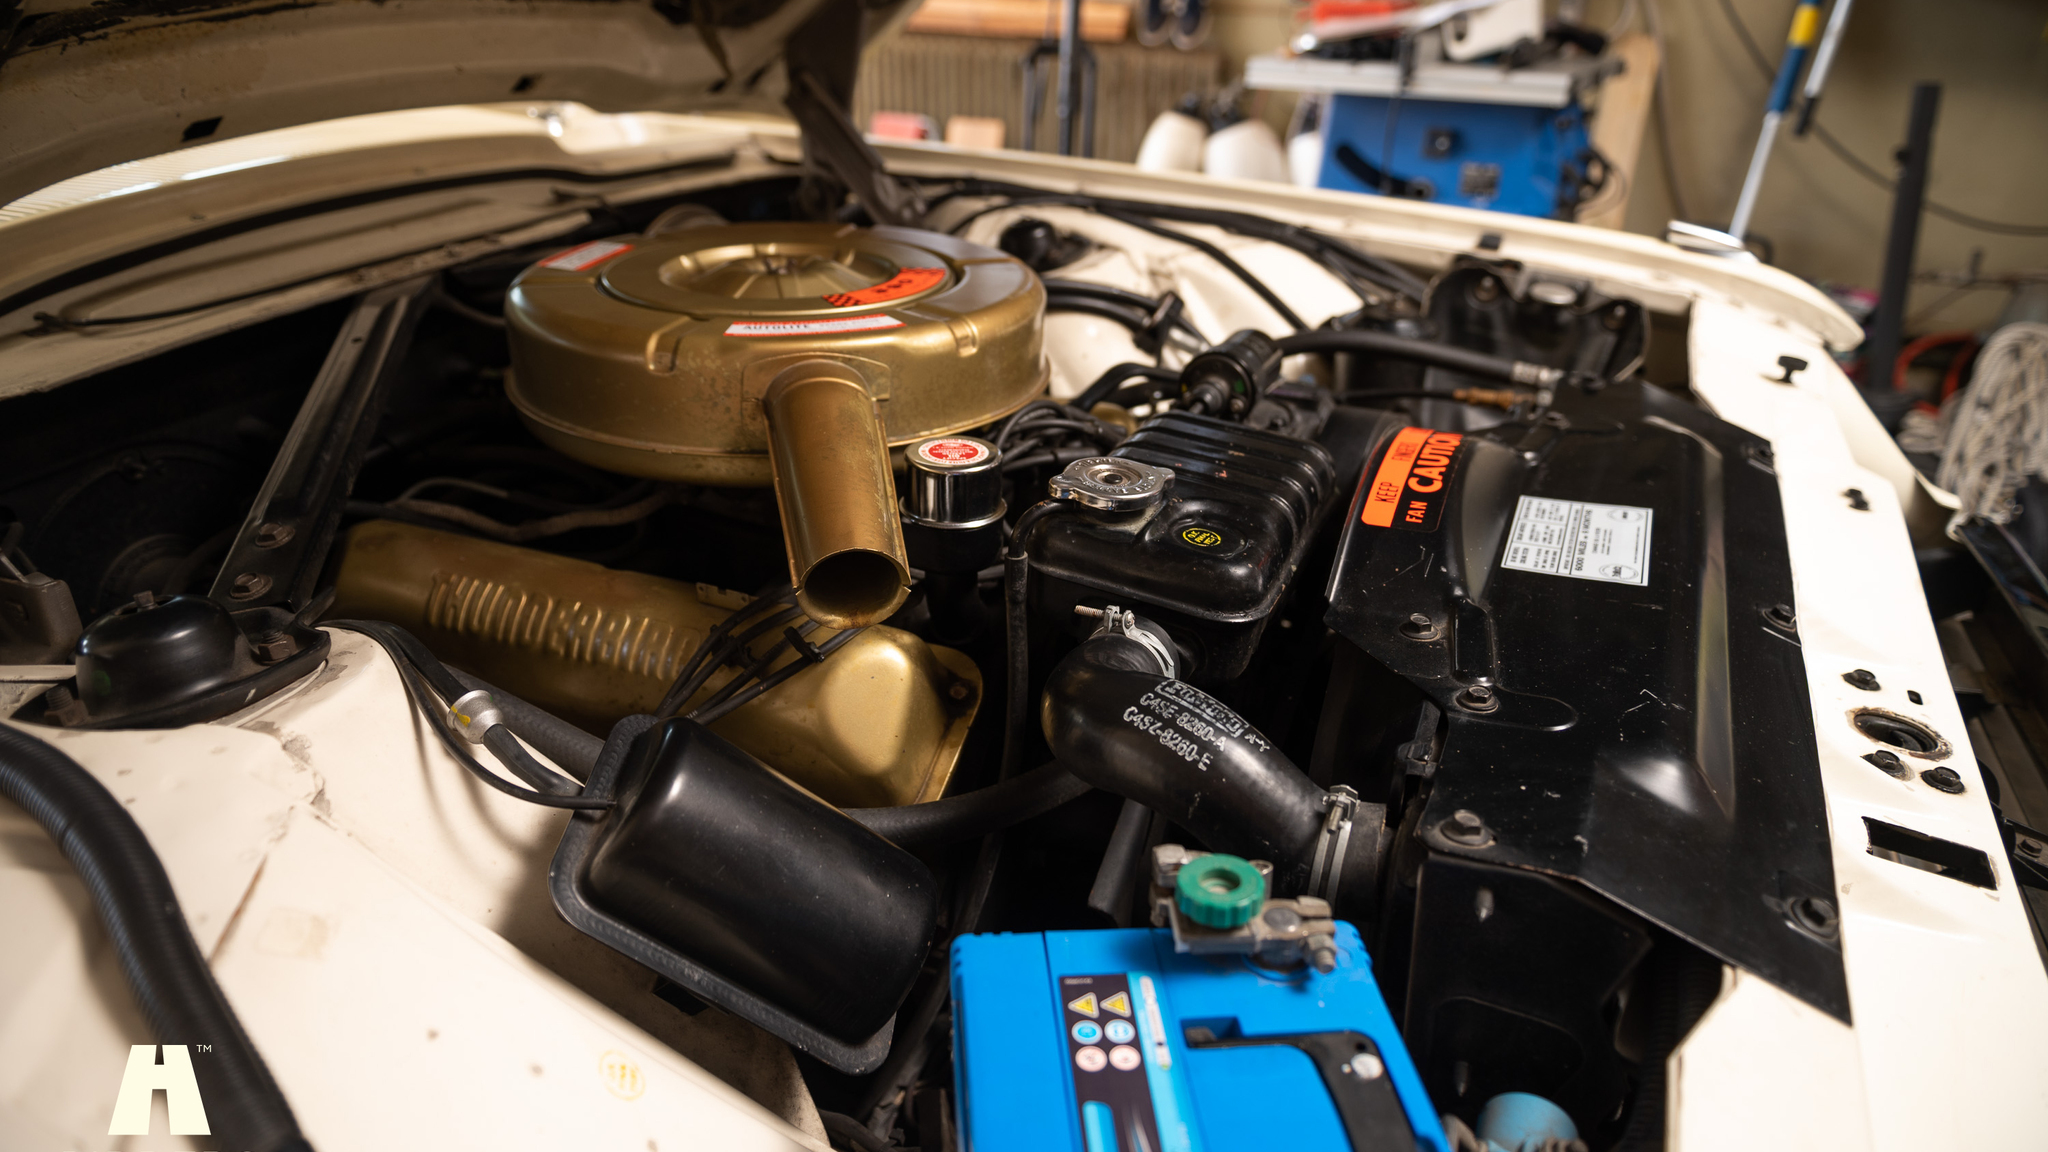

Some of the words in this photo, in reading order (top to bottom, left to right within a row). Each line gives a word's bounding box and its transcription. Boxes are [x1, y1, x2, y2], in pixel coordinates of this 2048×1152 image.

[743, 322, 810, 331] AUTOLITE
[1375, 482, 1400, 503] KEEP
[1405, 501, 1428, 523] FAN
